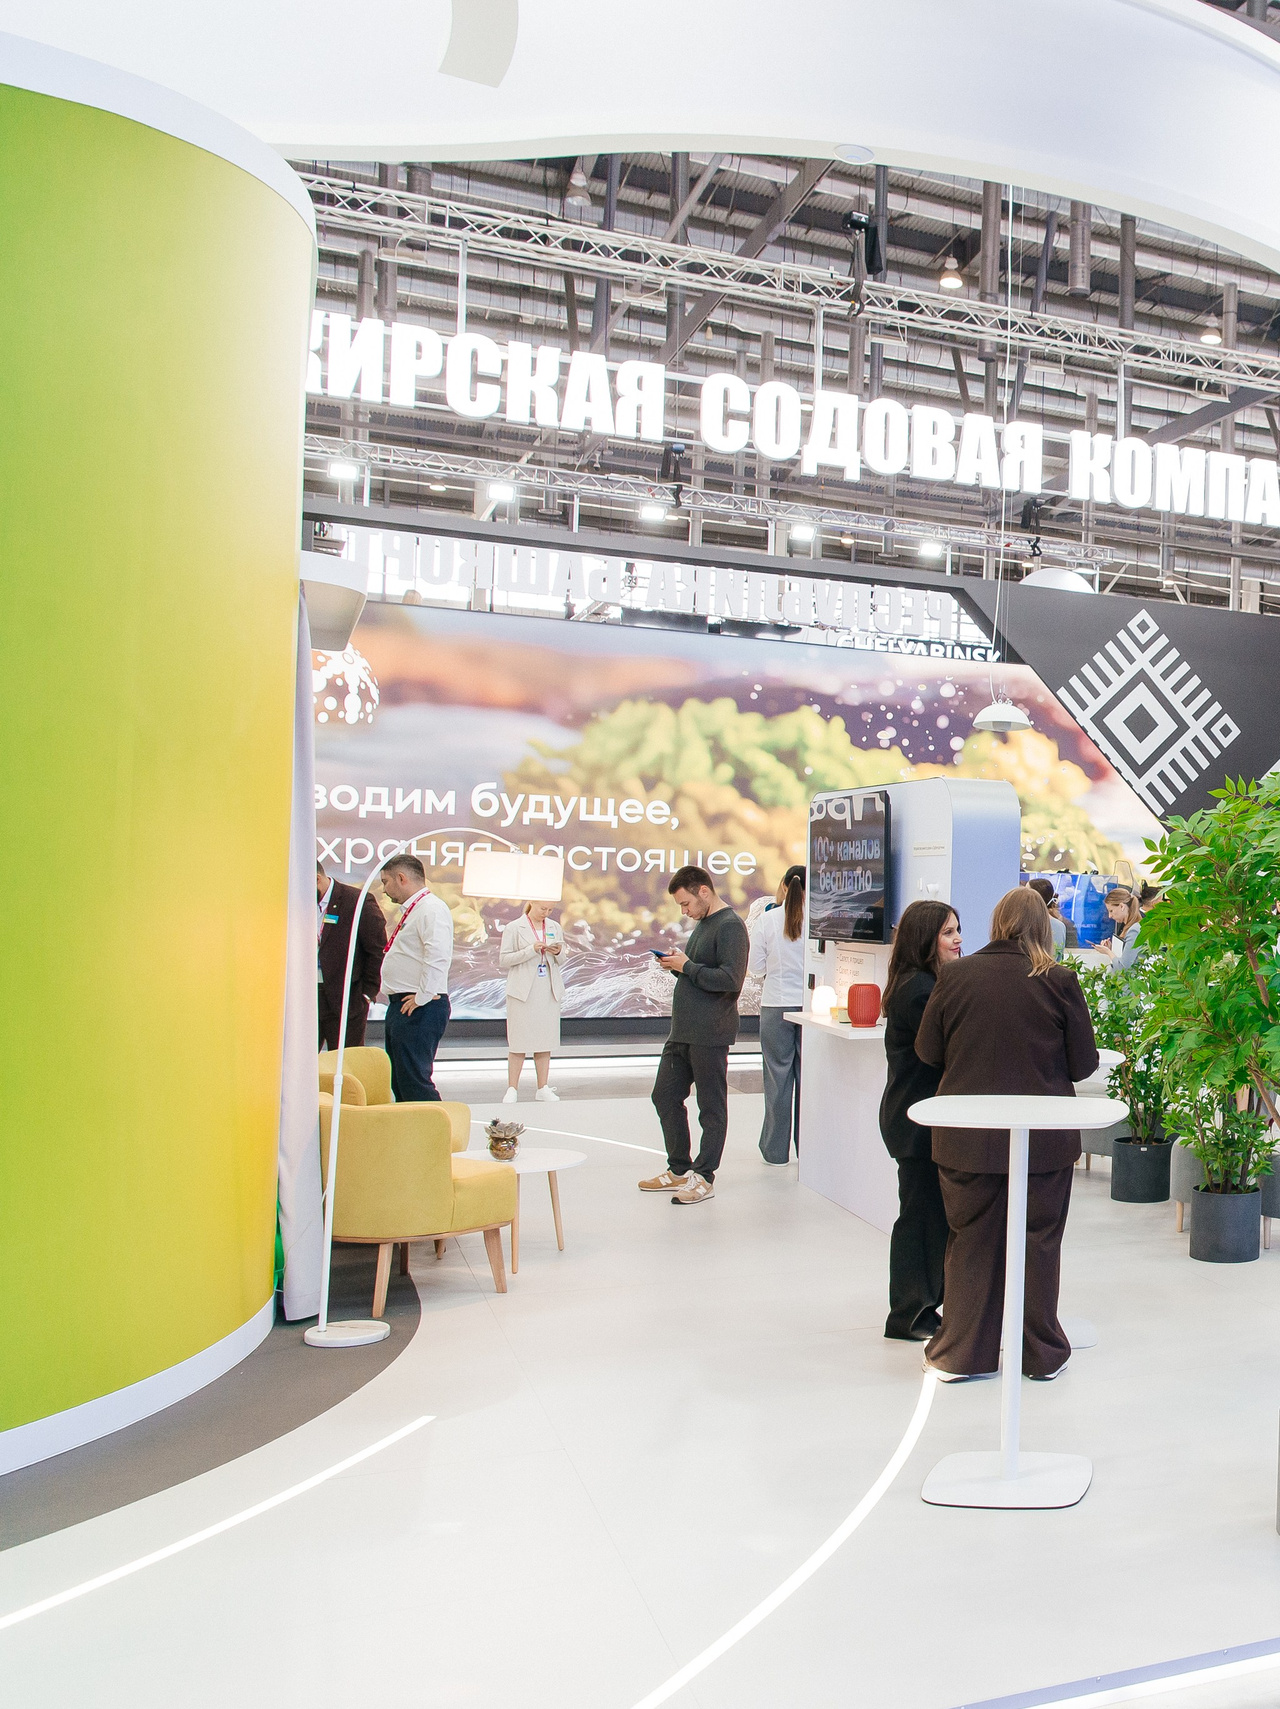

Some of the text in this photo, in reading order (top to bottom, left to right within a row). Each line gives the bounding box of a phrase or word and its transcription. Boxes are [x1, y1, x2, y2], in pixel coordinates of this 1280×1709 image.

[699, 372, 1043, 495] СОДОВАЯ
[471, 781, 680, 831] будущее,
[511, 843, 757, 876] астоящее
[837, 838, 881, 861] каналов
[818, 862, 873, 892] бесплатно
